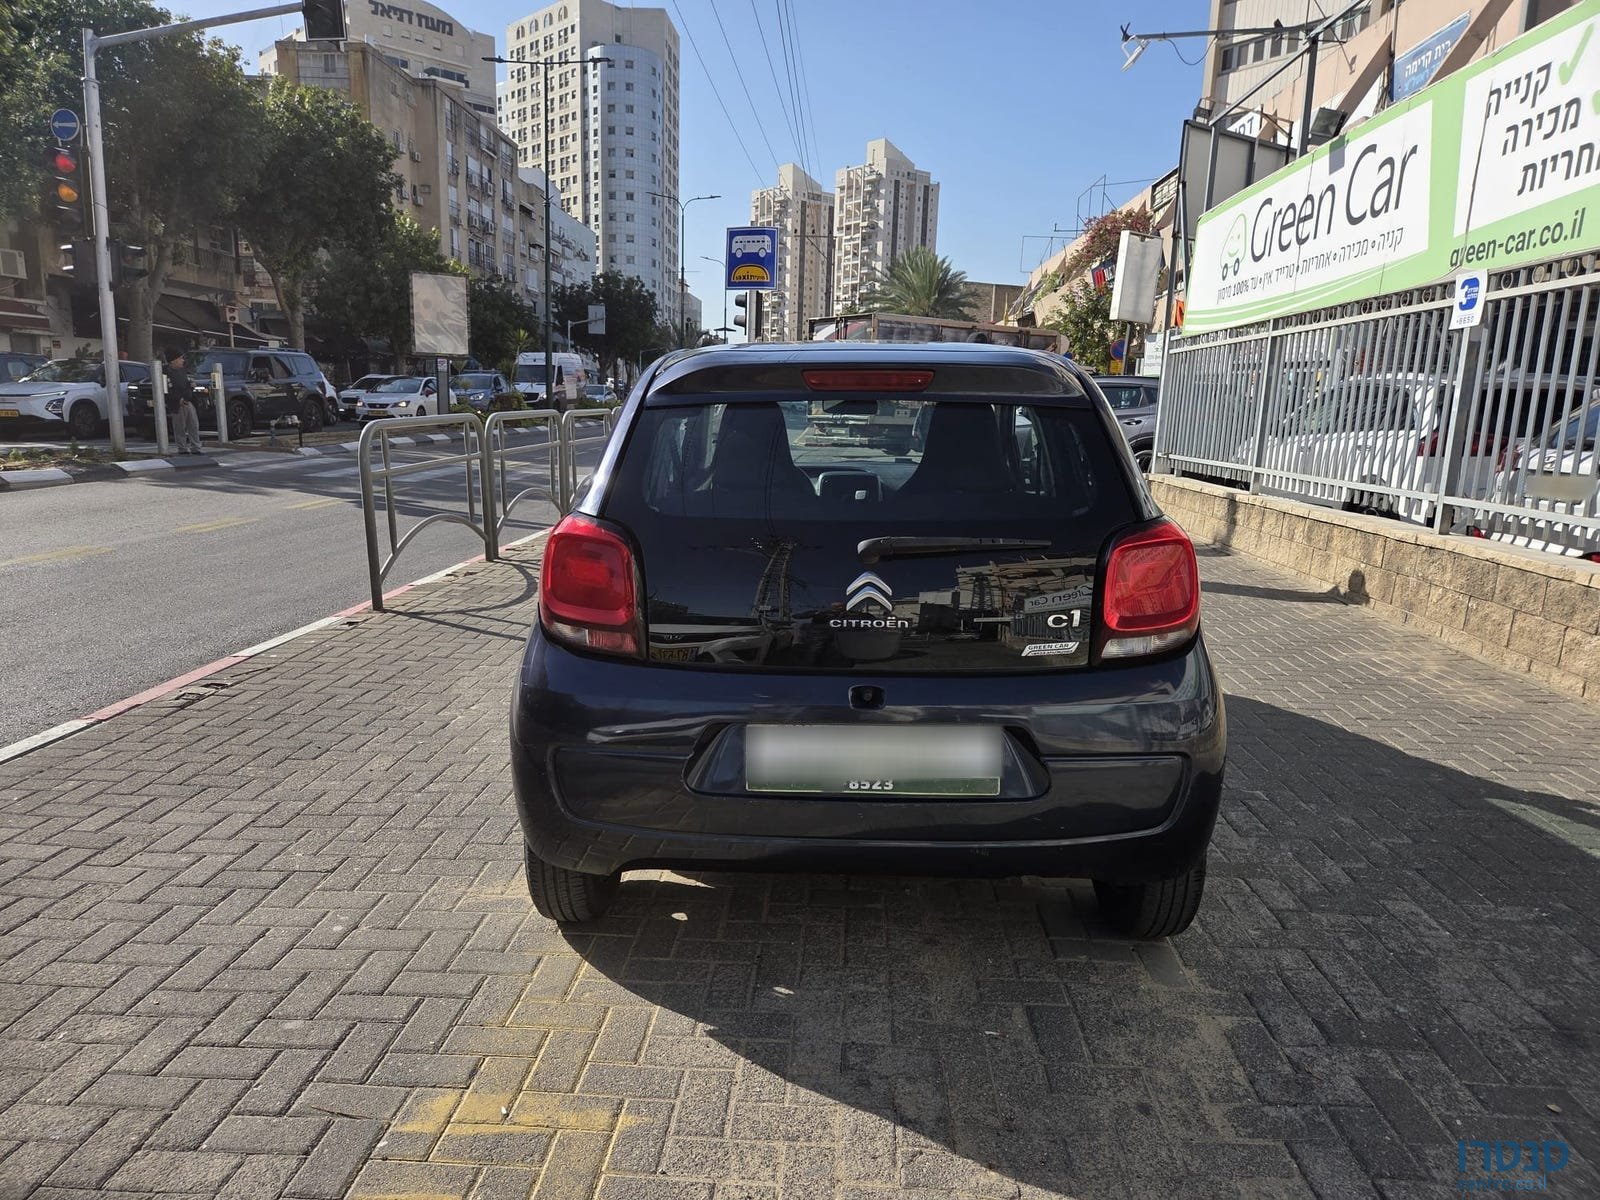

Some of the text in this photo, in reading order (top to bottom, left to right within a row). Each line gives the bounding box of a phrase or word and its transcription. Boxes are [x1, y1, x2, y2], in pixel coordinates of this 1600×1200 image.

[1486, 62, 1552, 121] קניית
[1502, 96, 1582, 157] מכירה
[1517, 138, 1600, 197] חריות
[1250, 142, 1418, 263] Green Car
[1339, 238, 1368, 263] מכירה
[1378, 227, 1404, 252] קניה
[1300, 252, 1332, 276] אחריות
[1232, 280, 1250, 297] 100%
[1047, 609, 1081, 628] C1
